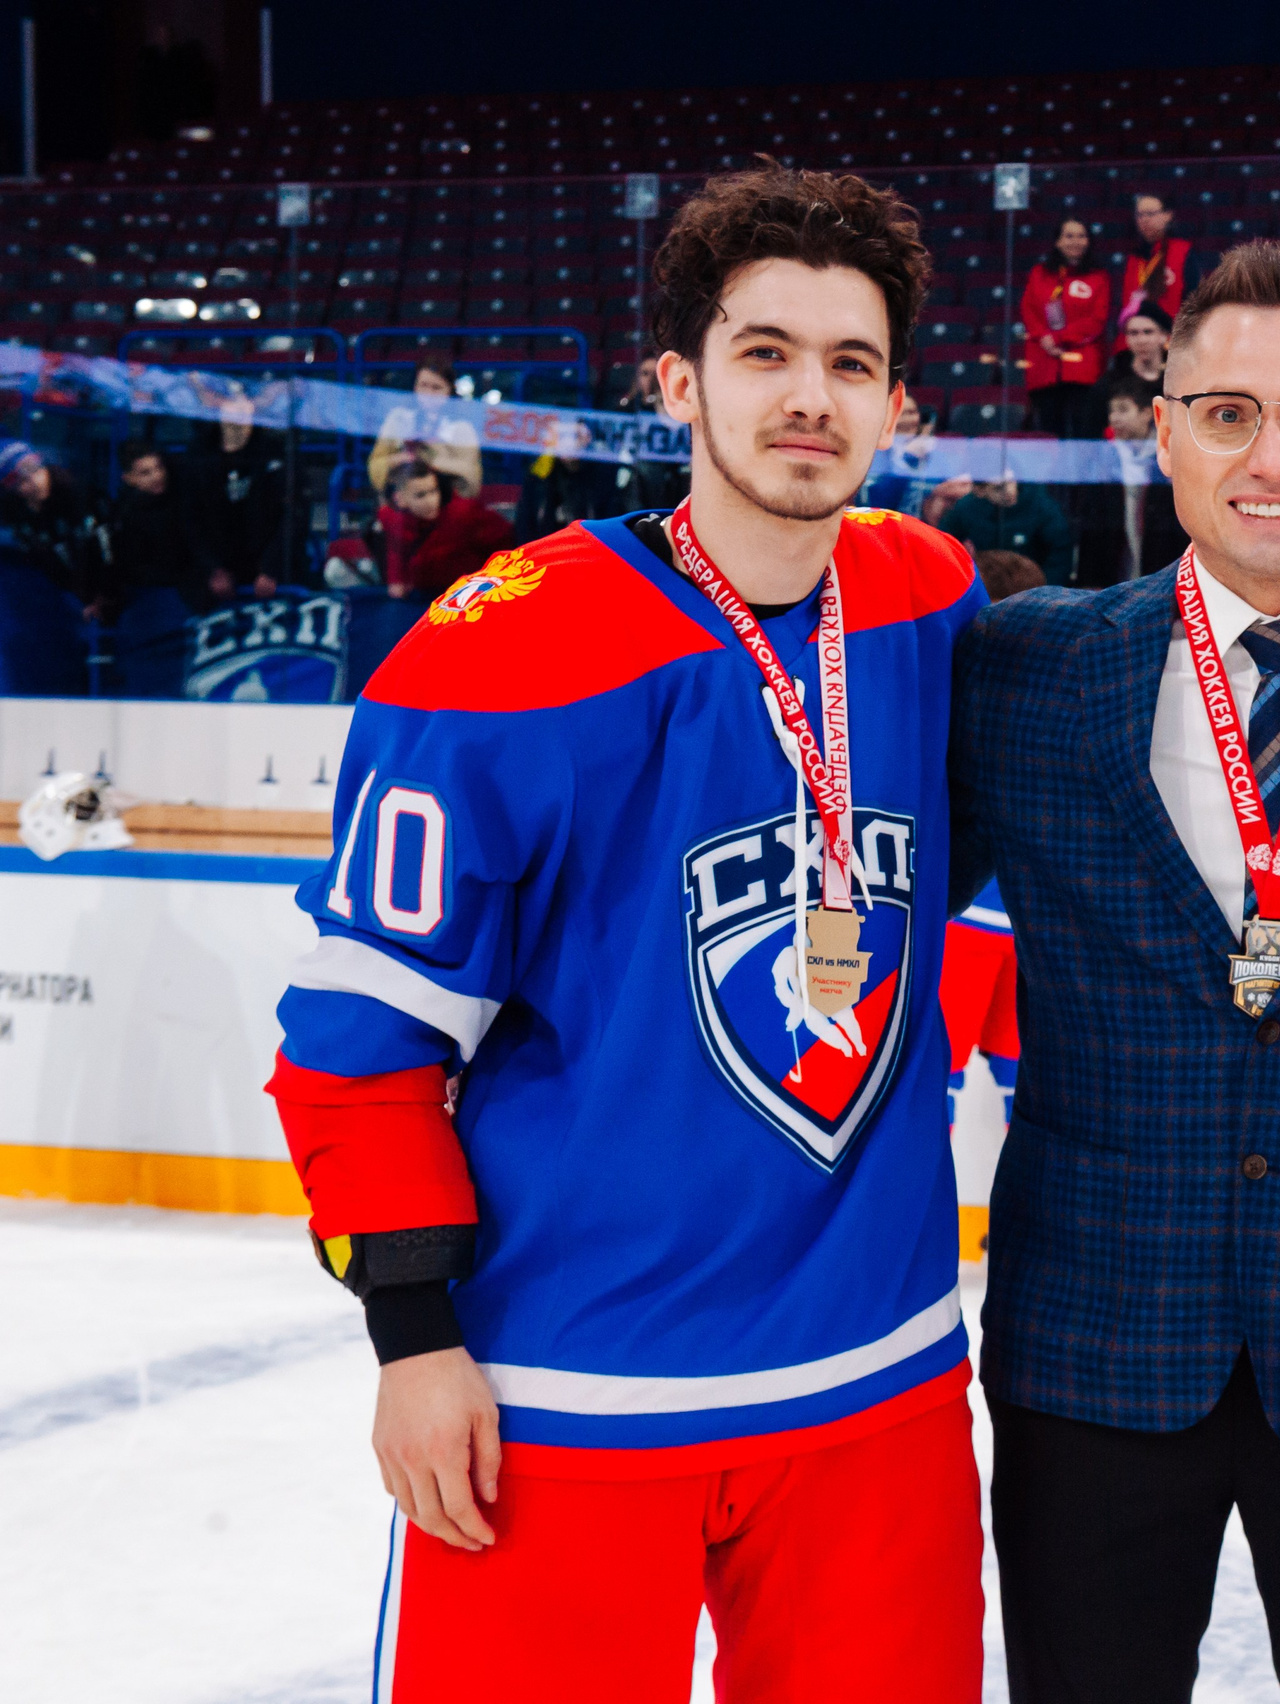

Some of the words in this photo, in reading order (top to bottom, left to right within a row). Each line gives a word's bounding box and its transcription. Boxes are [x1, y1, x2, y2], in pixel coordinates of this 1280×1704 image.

[676, 521, 755, 633] ФЕДЕРАЦИЯ
[745, 632, 801, 716] ХОККЕЯ
[792, 718, 838, 815] РОССИИ
[1195, 643, 1233, 729] ХОККЕЯ
[1219, 731, 1262, 824] РОССИИ
[327, 768, 446, 936] 10
